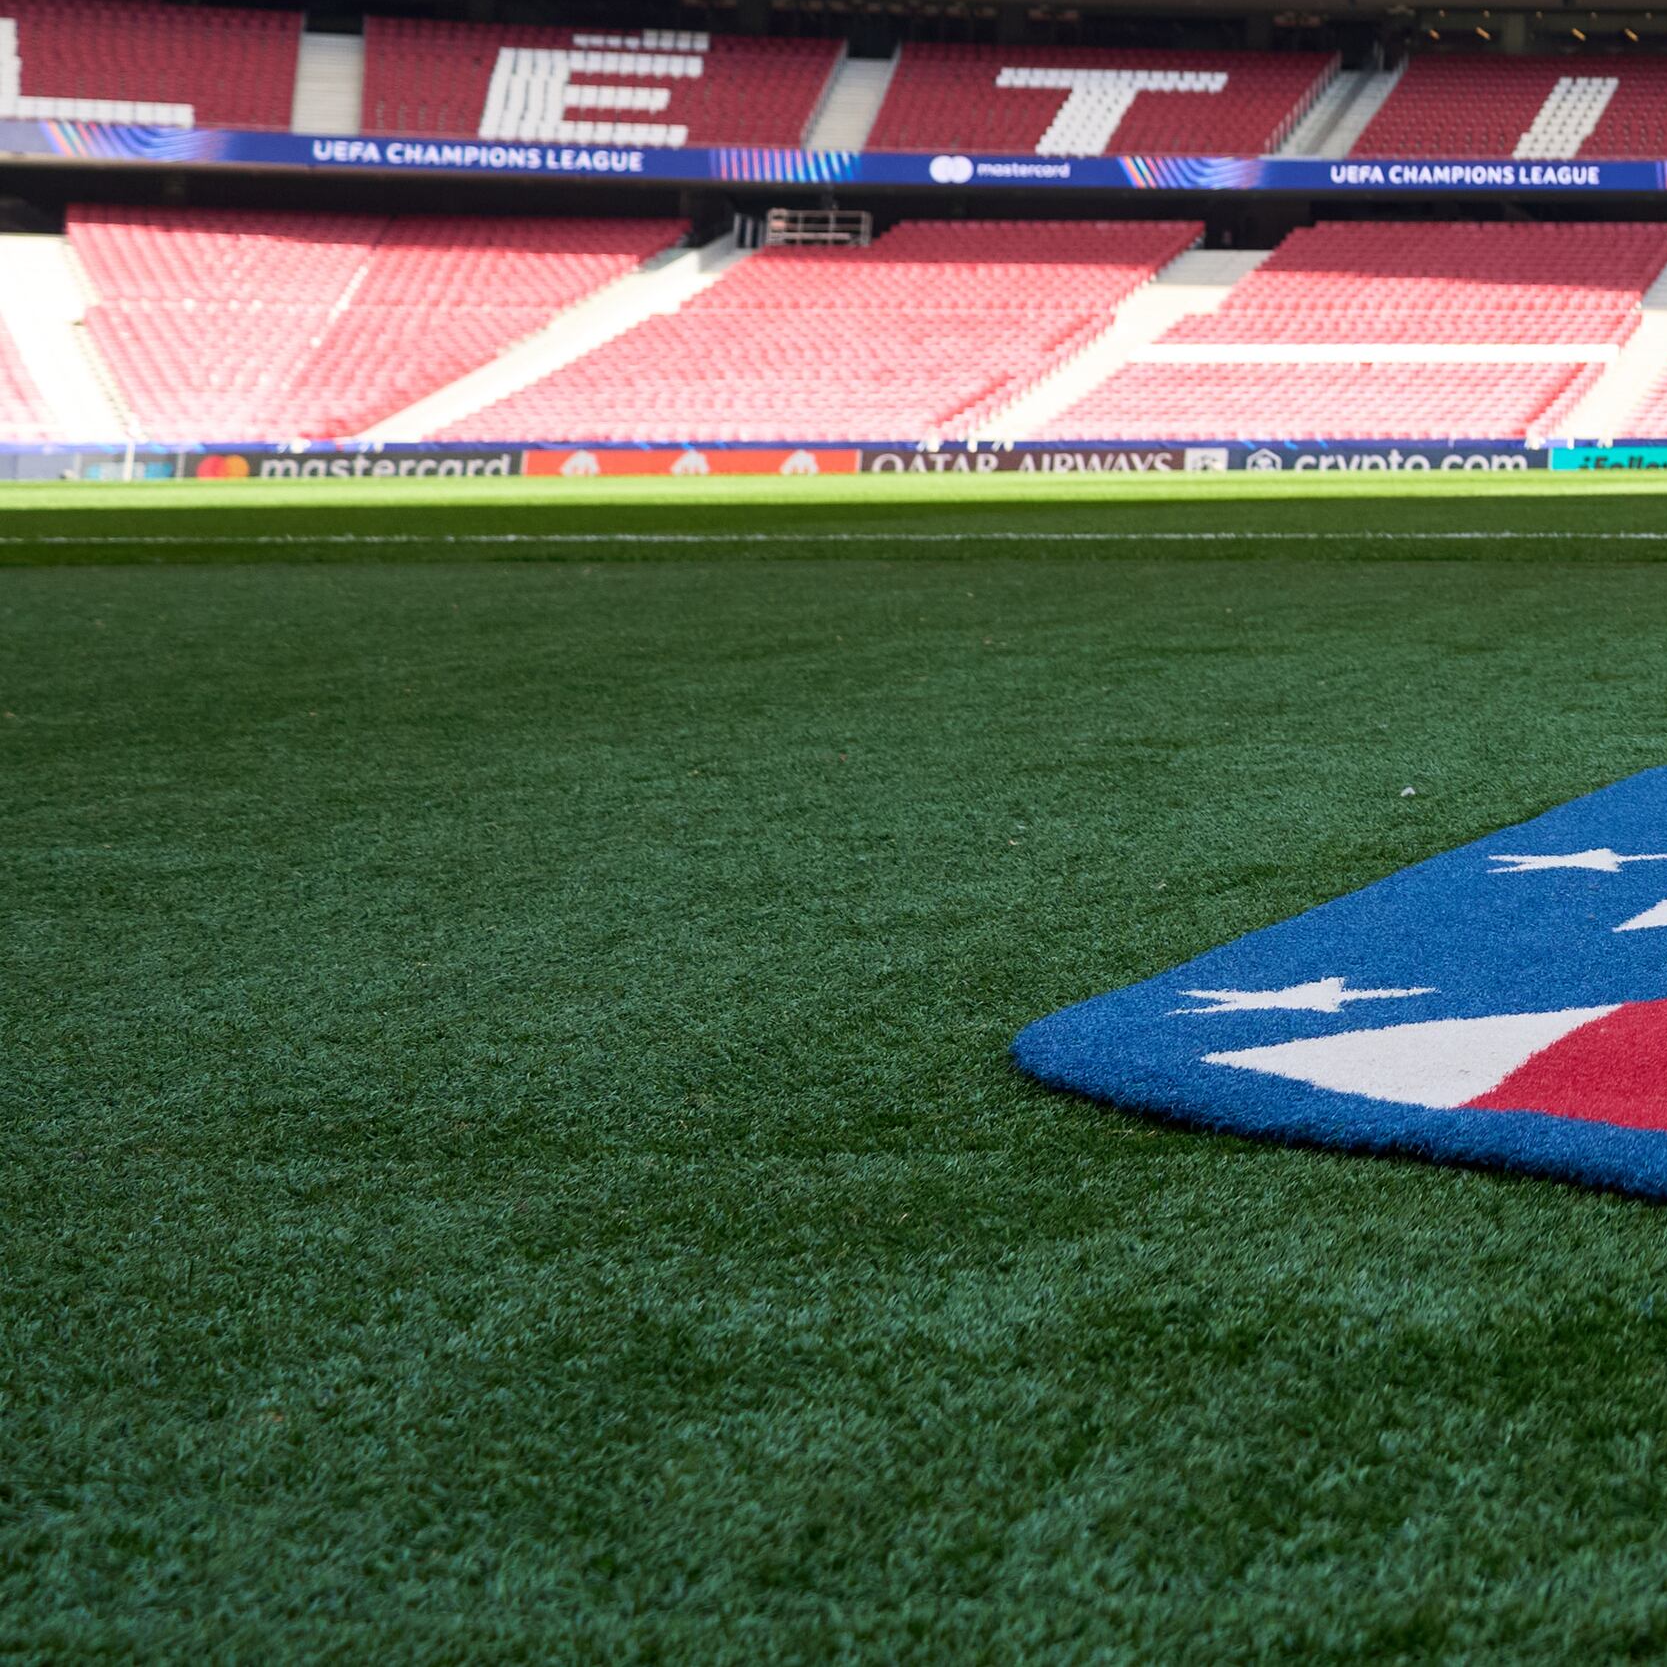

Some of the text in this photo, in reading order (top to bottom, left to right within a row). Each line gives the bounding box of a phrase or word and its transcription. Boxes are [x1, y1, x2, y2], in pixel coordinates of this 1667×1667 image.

[313, 140, 645, 172] UEFA CHAMPIONS LEAGUE
[1330, 165, 1600, 185] UEFA CHAMPIONS LEAGUE
[260, 453, 510, 478] mastercard
[1019, 452, 1173, 472] AIRWAYS
